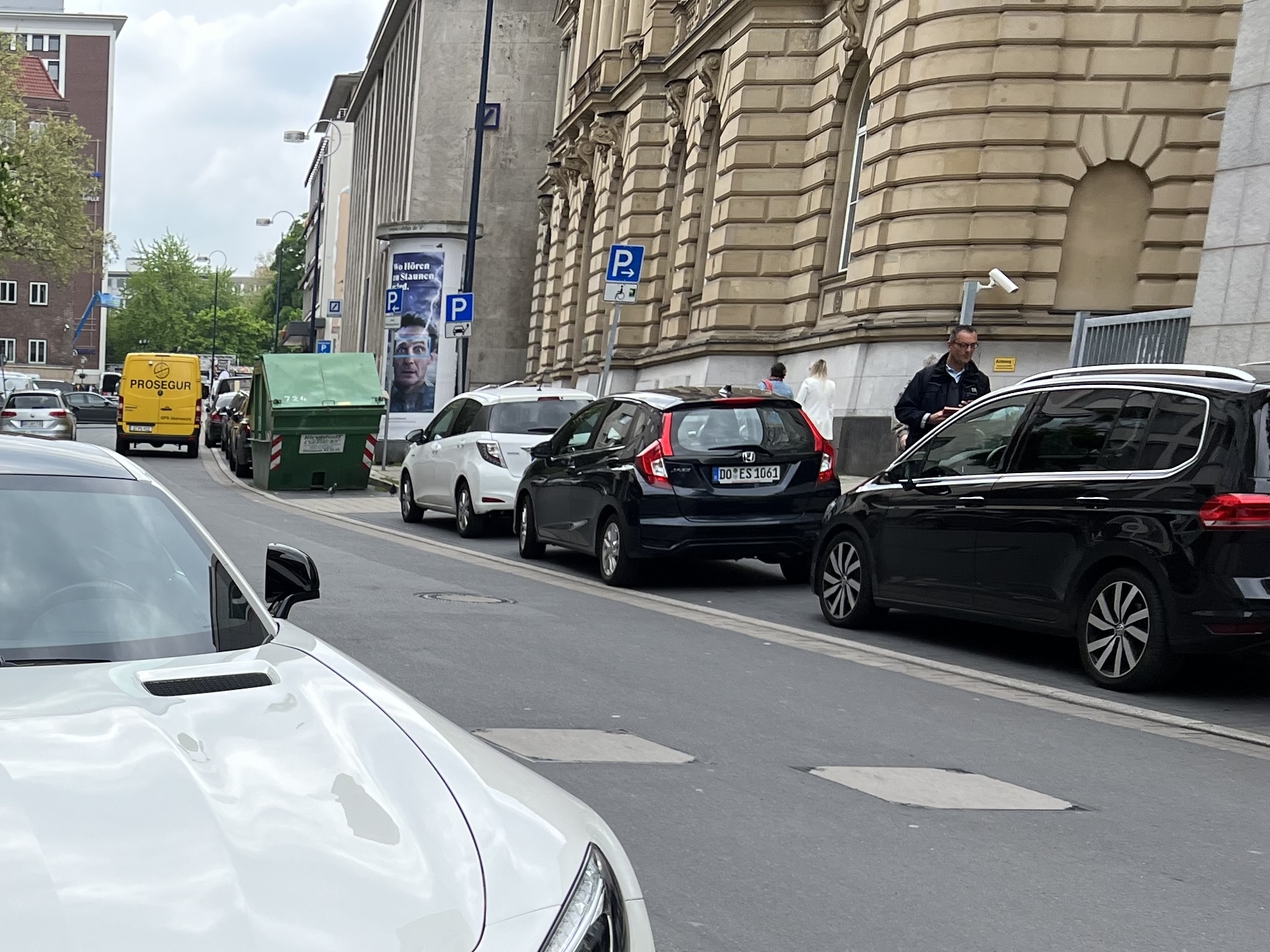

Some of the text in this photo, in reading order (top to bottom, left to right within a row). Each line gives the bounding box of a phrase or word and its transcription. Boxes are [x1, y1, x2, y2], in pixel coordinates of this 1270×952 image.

[404, 262, 430, 270] Hören
[612, 249, 633, 276] P
[400, 272, 435, 281] Staunen
[388, 291, 398, 311] P
[451, 297, 467, 321] P
[130, 379, 191, 390] PROSEGUR
[720, 467, 778, 480] DO ES 1061
